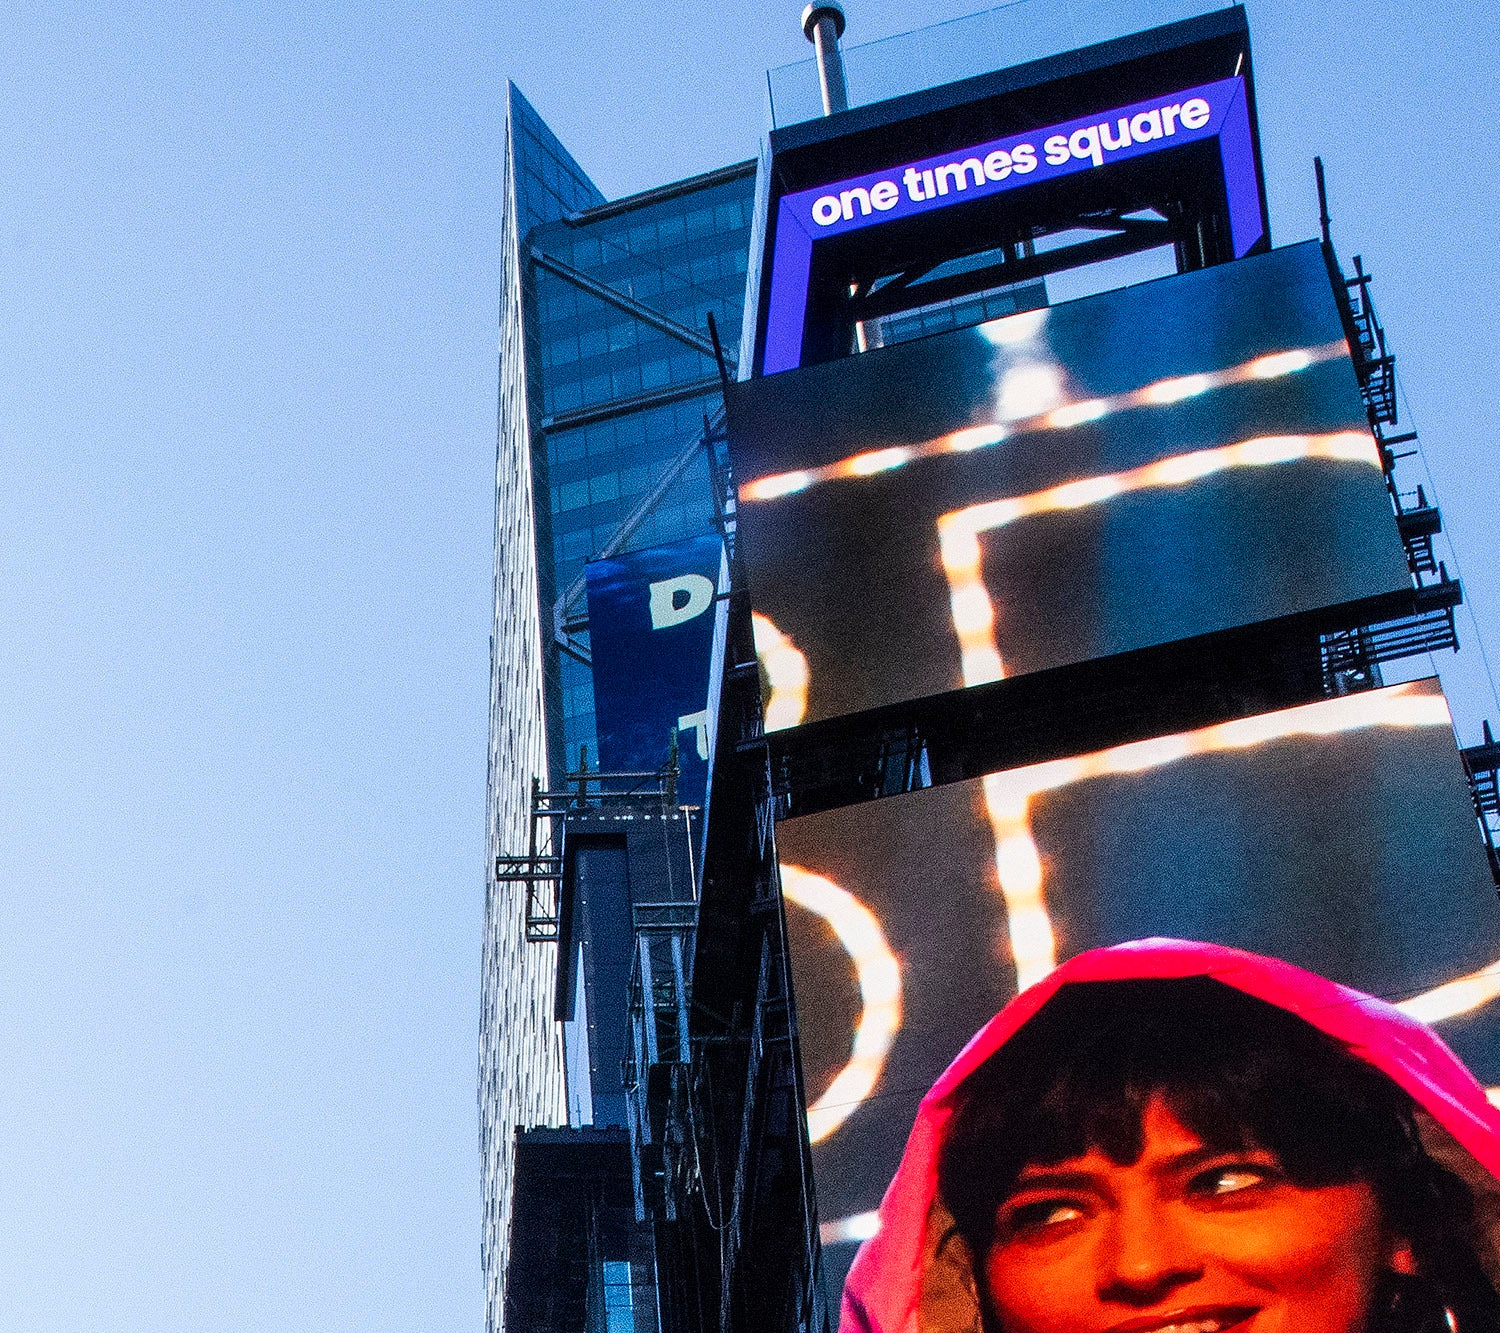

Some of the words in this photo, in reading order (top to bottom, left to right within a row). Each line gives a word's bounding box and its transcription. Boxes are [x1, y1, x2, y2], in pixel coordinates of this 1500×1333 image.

[810, 179, 900, 229] one
[902, 144, 1038, 200] times
[1045, 96, 1211, 169] square
